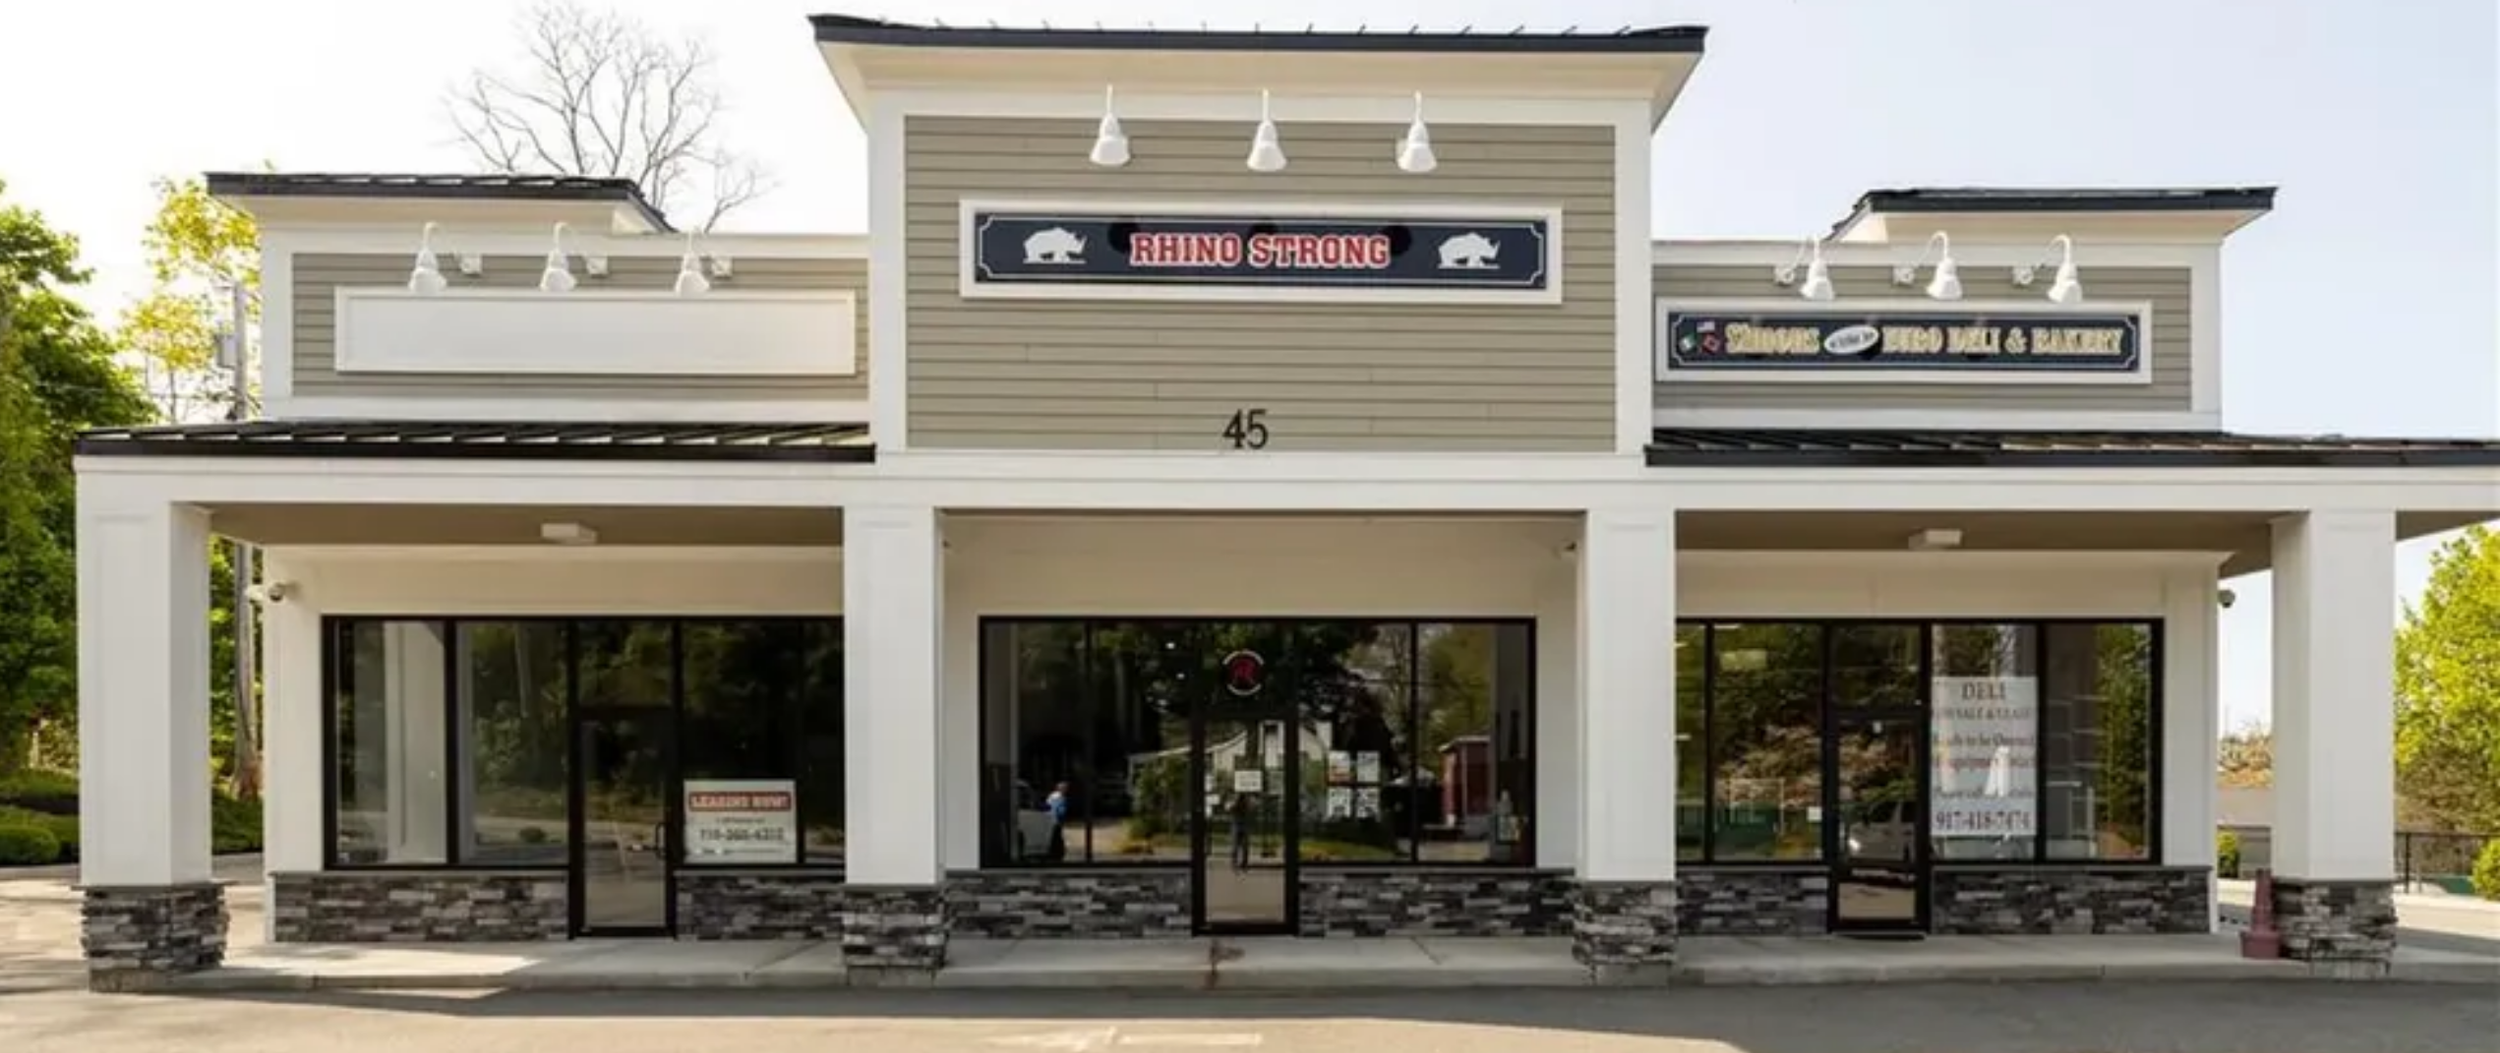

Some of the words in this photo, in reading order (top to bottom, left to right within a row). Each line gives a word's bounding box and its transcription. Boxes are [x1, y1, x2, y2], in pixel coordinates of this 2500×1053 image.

[1130, 232, 1241, 267] RHINO
[1248, 234, 1392, 269] STRONG
[1947, 326, 2001, 354] DELI
[2004, 326, 2028, 354] &
[2031, 326, 2126, 355] BAKERY
[1222, 408, 1269, 450] 45
[1961, 681, 2006, 701] DELI
